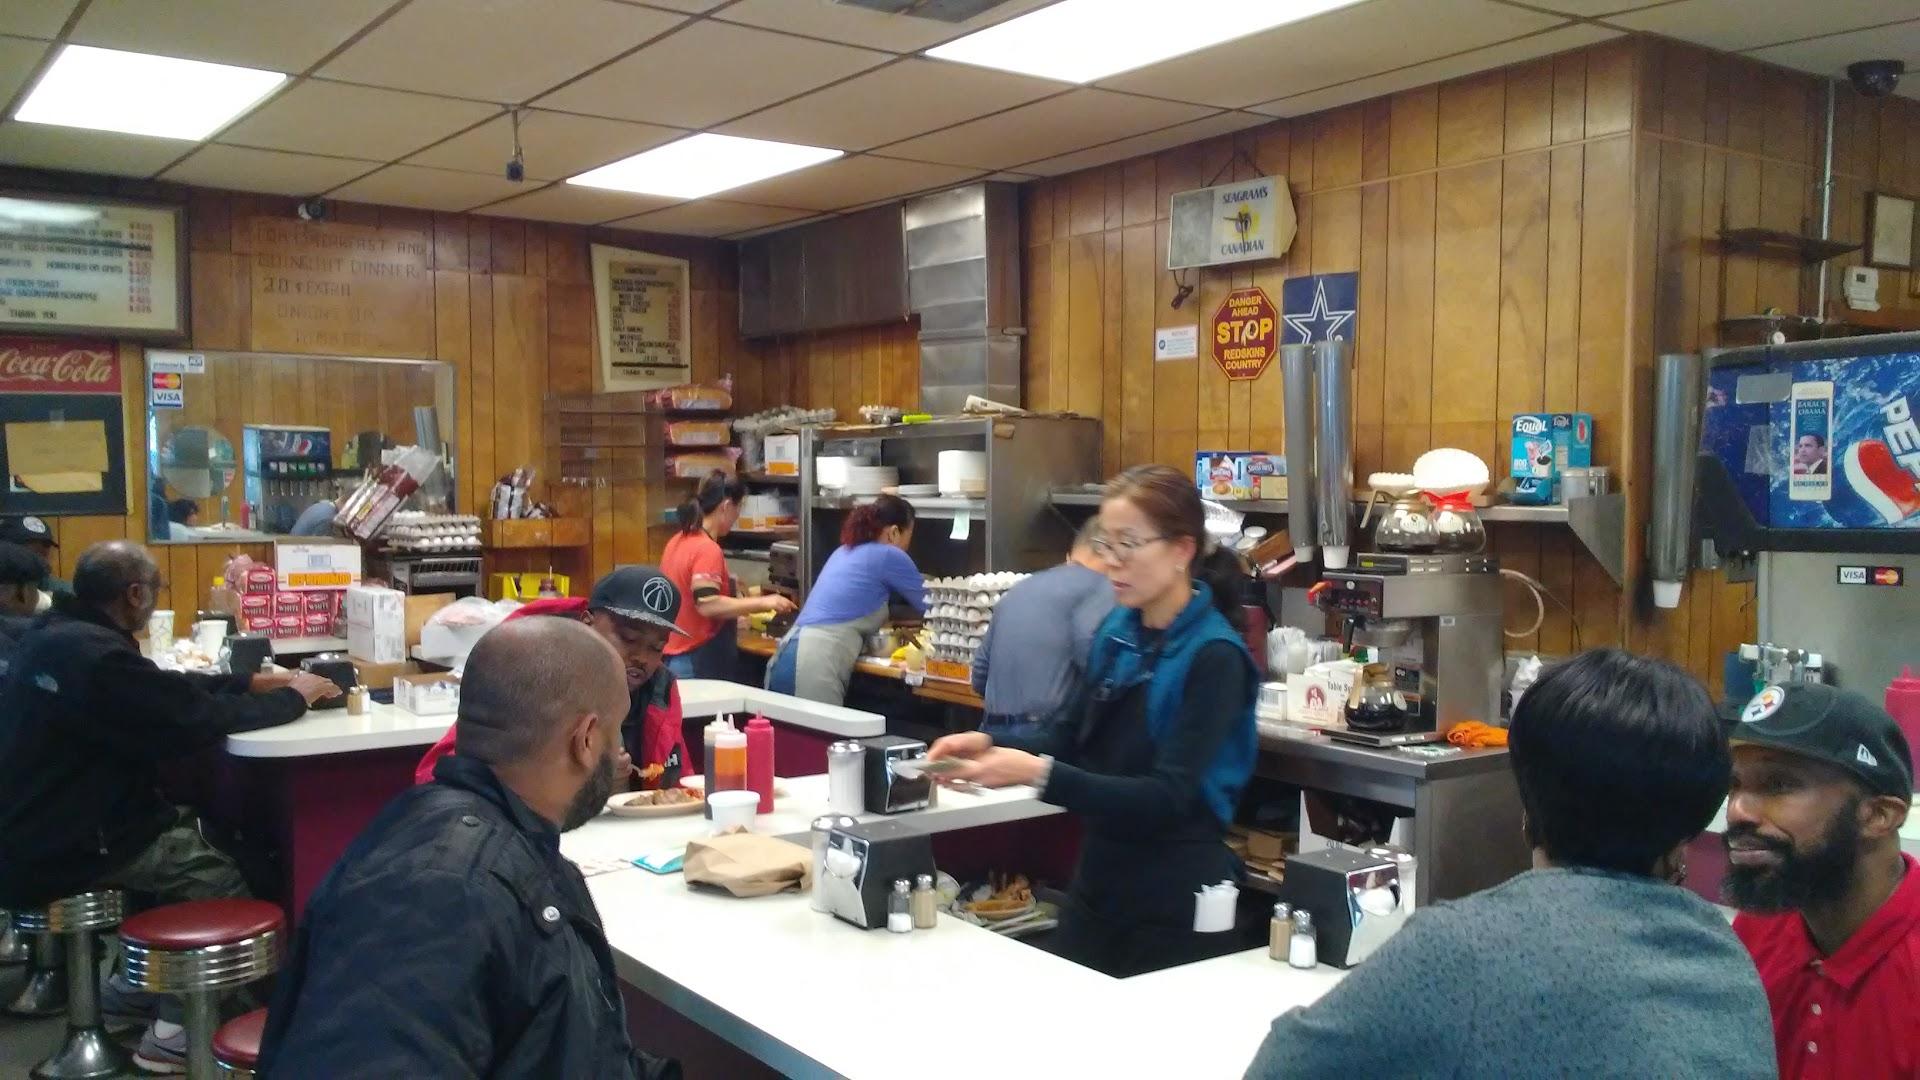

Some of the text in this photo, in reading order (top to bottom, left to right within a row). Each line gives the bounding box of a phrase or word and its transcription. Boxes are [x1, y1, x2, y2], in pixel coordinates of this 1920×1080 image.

[1221, 240, 1265, 255] CANADIAN
[1229, 297, 1261, 308] DANGER
[1231, 307, 1258, 317] AHEAD
[1217, 317, 1272, 345] STOP
[1223, 347, 1266, 361] REDSKINS
[1225, 359, 1262, 371] COUNTRY
[156, 393, 181, 401] VISA
[1798, 408, 1826, 416] OBAMA
[1843, 571, 1865, 579] VISA
